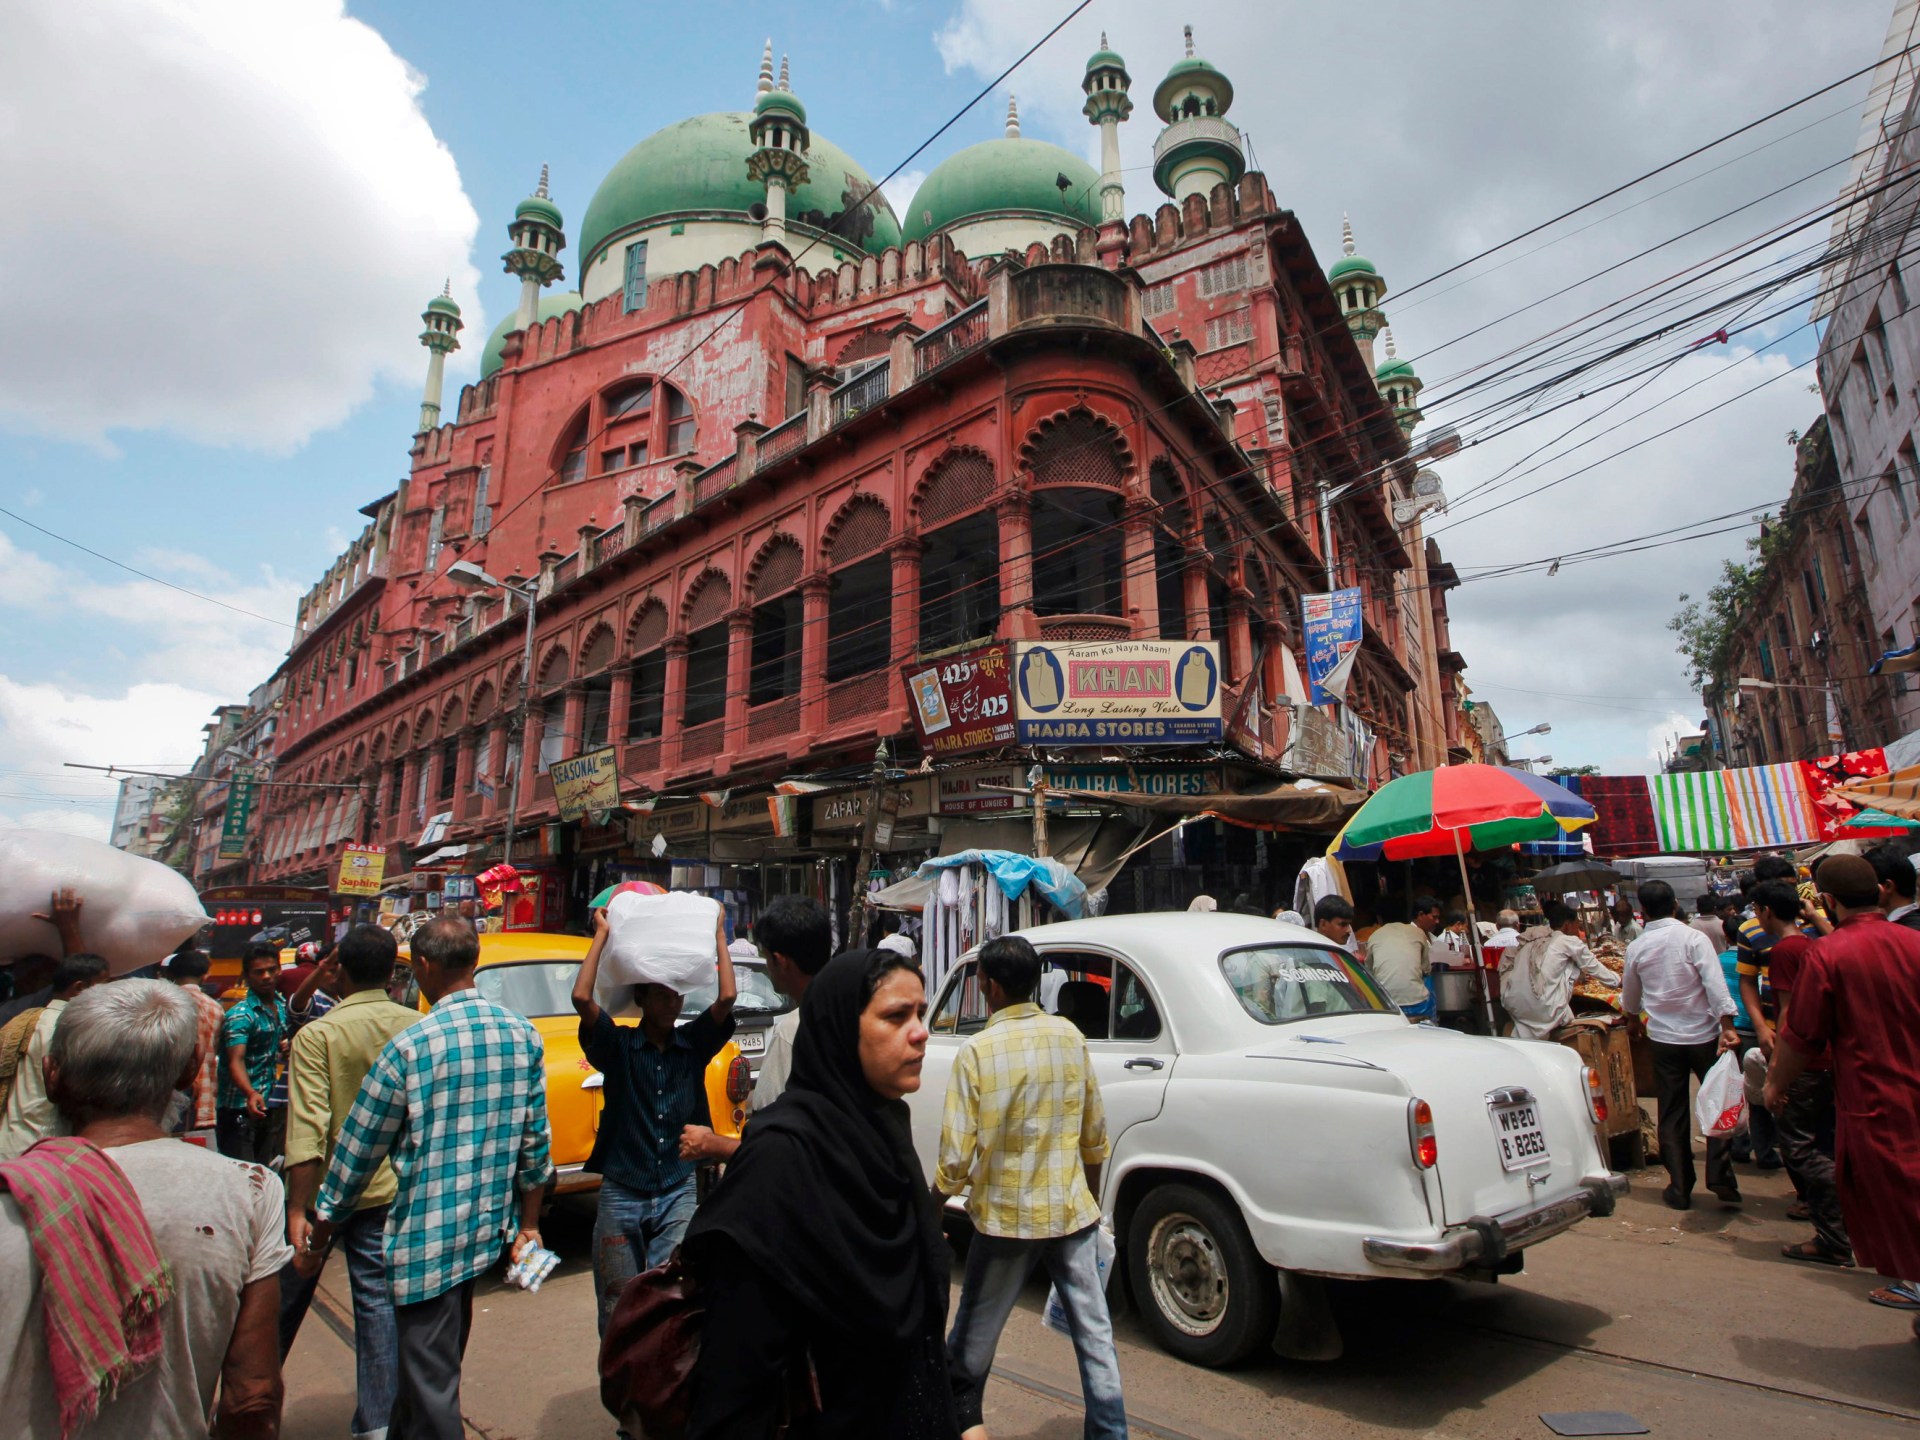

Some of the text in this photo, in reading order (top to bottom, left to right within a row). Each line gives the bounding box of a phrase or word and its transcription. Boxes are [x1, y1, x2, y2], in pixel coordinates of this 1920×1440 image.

[1068, 644, 1171, 658] Aaram Ka Naya Naam!
[942, 662, 970, 684] 425
[1078, 666, 1164, 692] KHAN
[981, 694, 1008, 717] 425
[1062, 701, 1181, 717] Long Lasting Vests
[1027, 721, 1165, 738] HAJRA STORES
[934, 727, 993, 752] HAJRA STORES
[553, 755, 599, 785] SEASONAL
[942, 775, 1011, 795] HAJRA STORES
[1054, 774, 1201, 794] HAJRA TORES
[824, 800, 860, 820] ZAFAR
[945, 801, 965, 811] HOUSE
[981, 798, 1008, 808] LUNGIES
[347, 843, 386, 854] SALE
[340, 877, 379, 888] Saphire
[1279, 968, 1349, 983] S@MISHU
[742, 1038, 761, 1047] 9485
